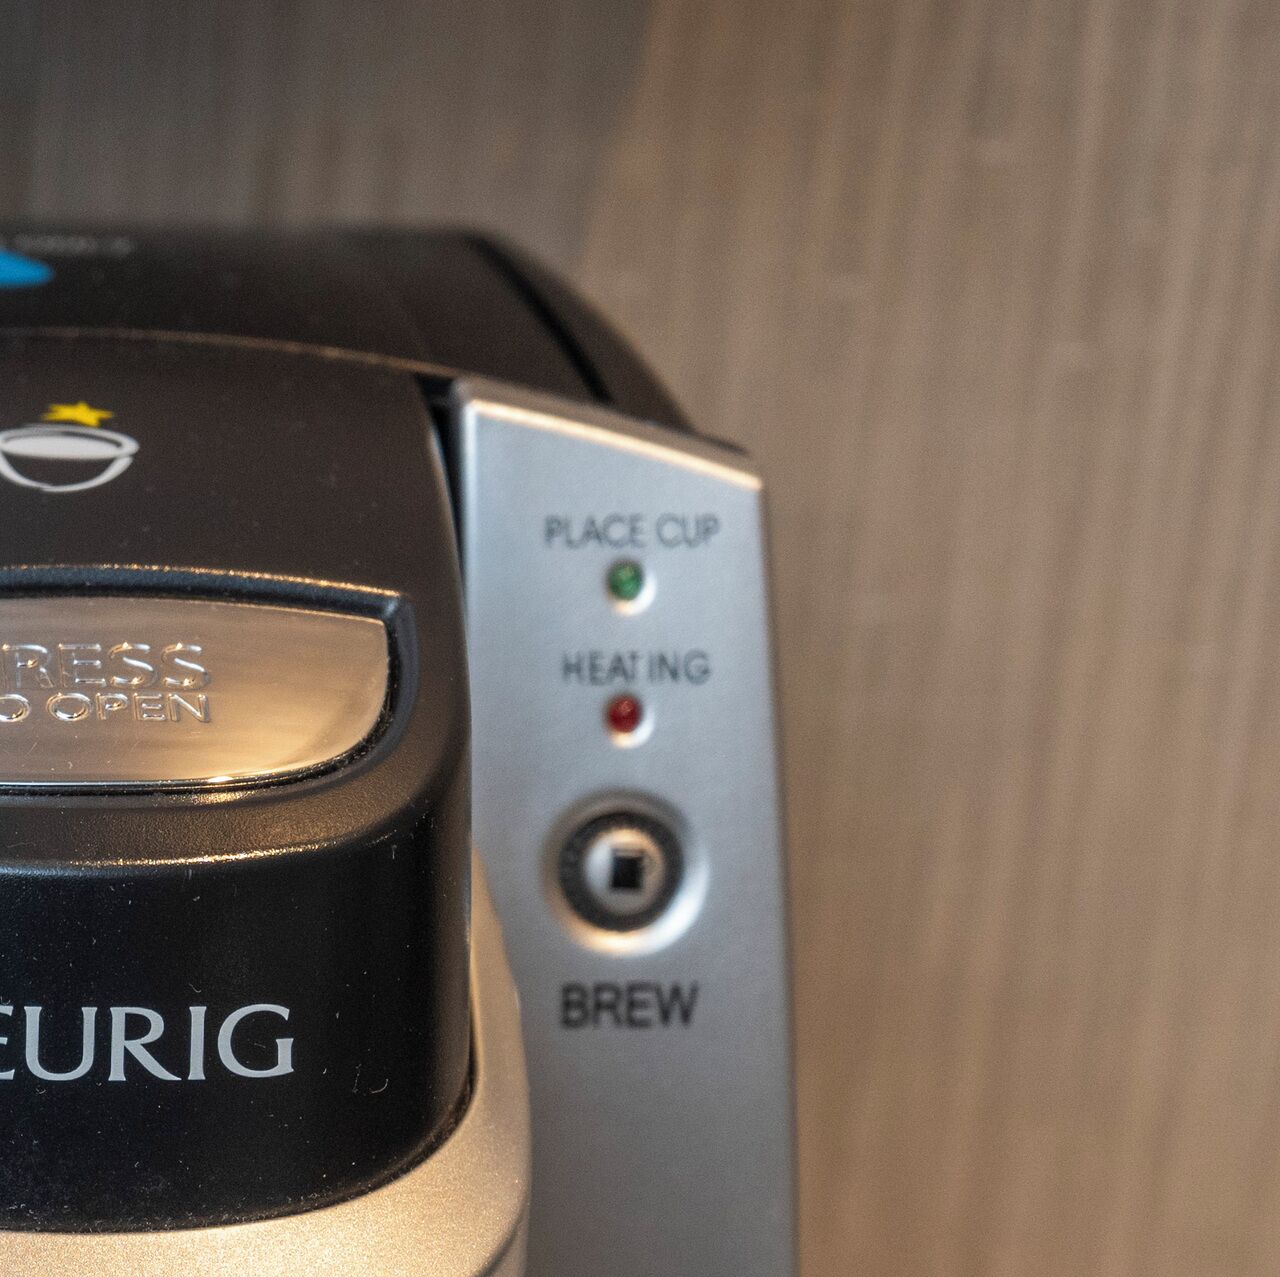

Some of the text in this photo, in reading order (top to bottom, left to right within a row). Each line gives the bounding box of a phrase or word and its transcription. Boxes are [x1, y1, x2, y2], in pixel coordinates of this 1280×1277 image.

[544, 513, 721, 549] PLACE CUP
[560, 650, 712, 686] HEATING
[46, 692, 211, 723] OPEN
[559, 981, 699, 1030] BREW
